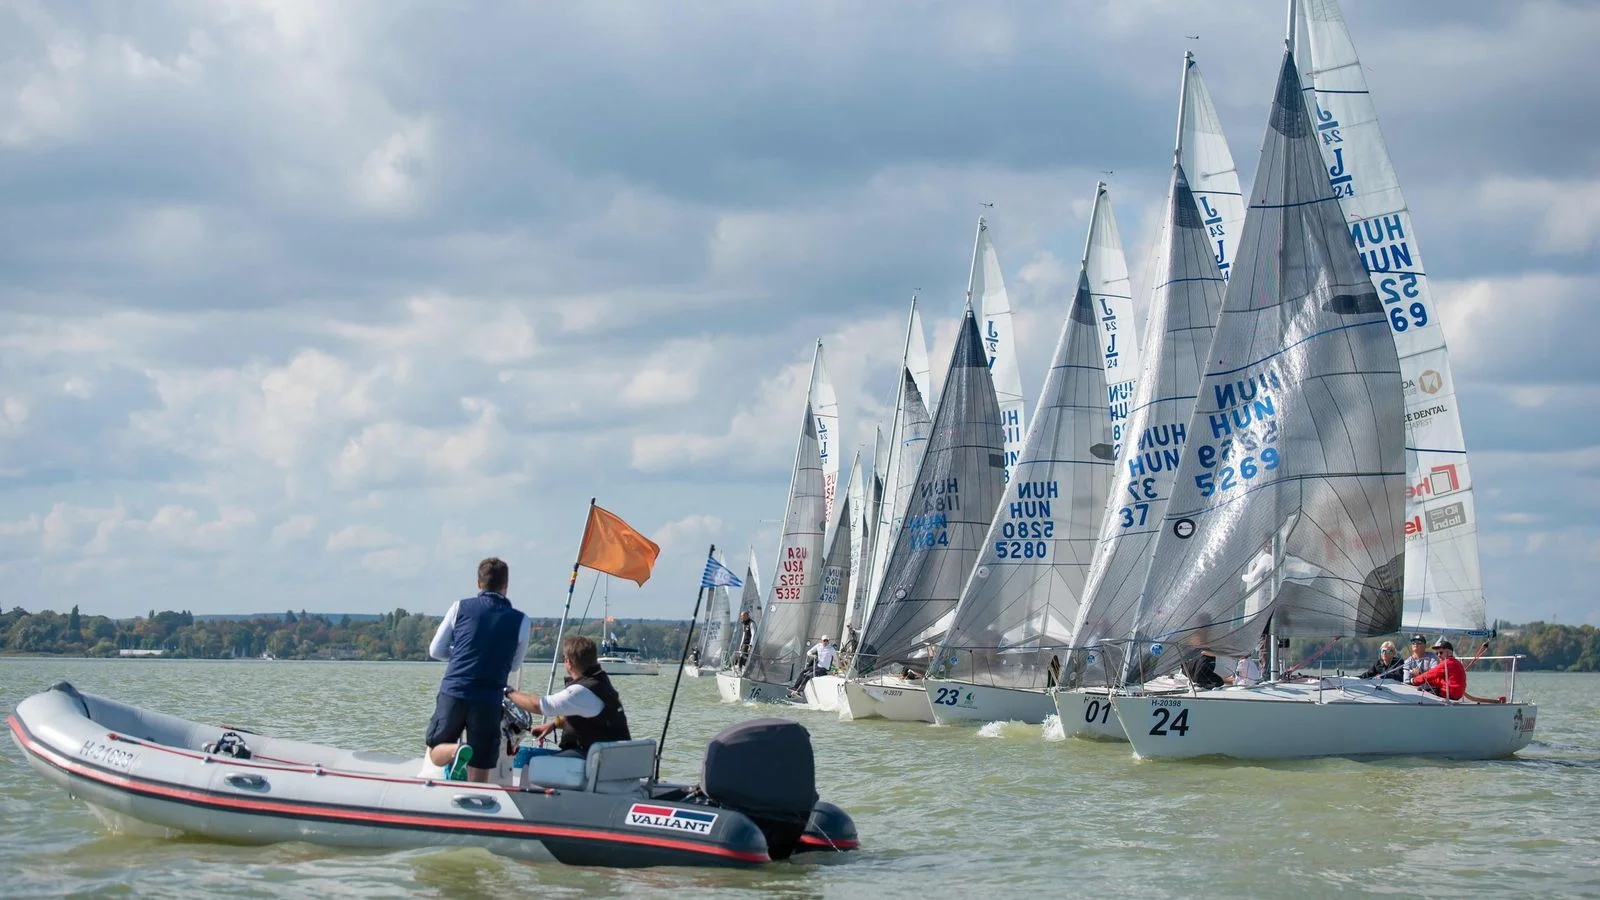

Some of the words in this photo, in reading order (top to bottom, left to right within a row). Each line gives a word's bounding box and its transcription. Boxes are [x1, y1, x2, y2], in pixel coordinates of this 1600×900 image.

[1334, 183, 1354, 200] 24
[1390, 302, 1428, 332] 69
[1107, 357, 1118, 369] 24
[1209, 396, 1275, 438] HUN
[1413, 405, 1447, 420] DENTAL
[1128, 448, 1179, 477] HUN
[1195, 447, 1280, 497] 5269
[1010, 501, 1051, 518] HUN
[1119, 504, 1149, 528] 37
[995, 541, 1047, 559] 5280
[783, 560, 804, 573] USA
[776, 587, 801, 600] 5352
[750, 687, 762, 699] 16
[934, 687, 960, 706] 23
[1085, 700, 1112, 724] 01
[1151, 699, 1182, 708] H-20398
[1149, 708, 1190, 736] 24
[631, 814, 709, 833] VALIANT
